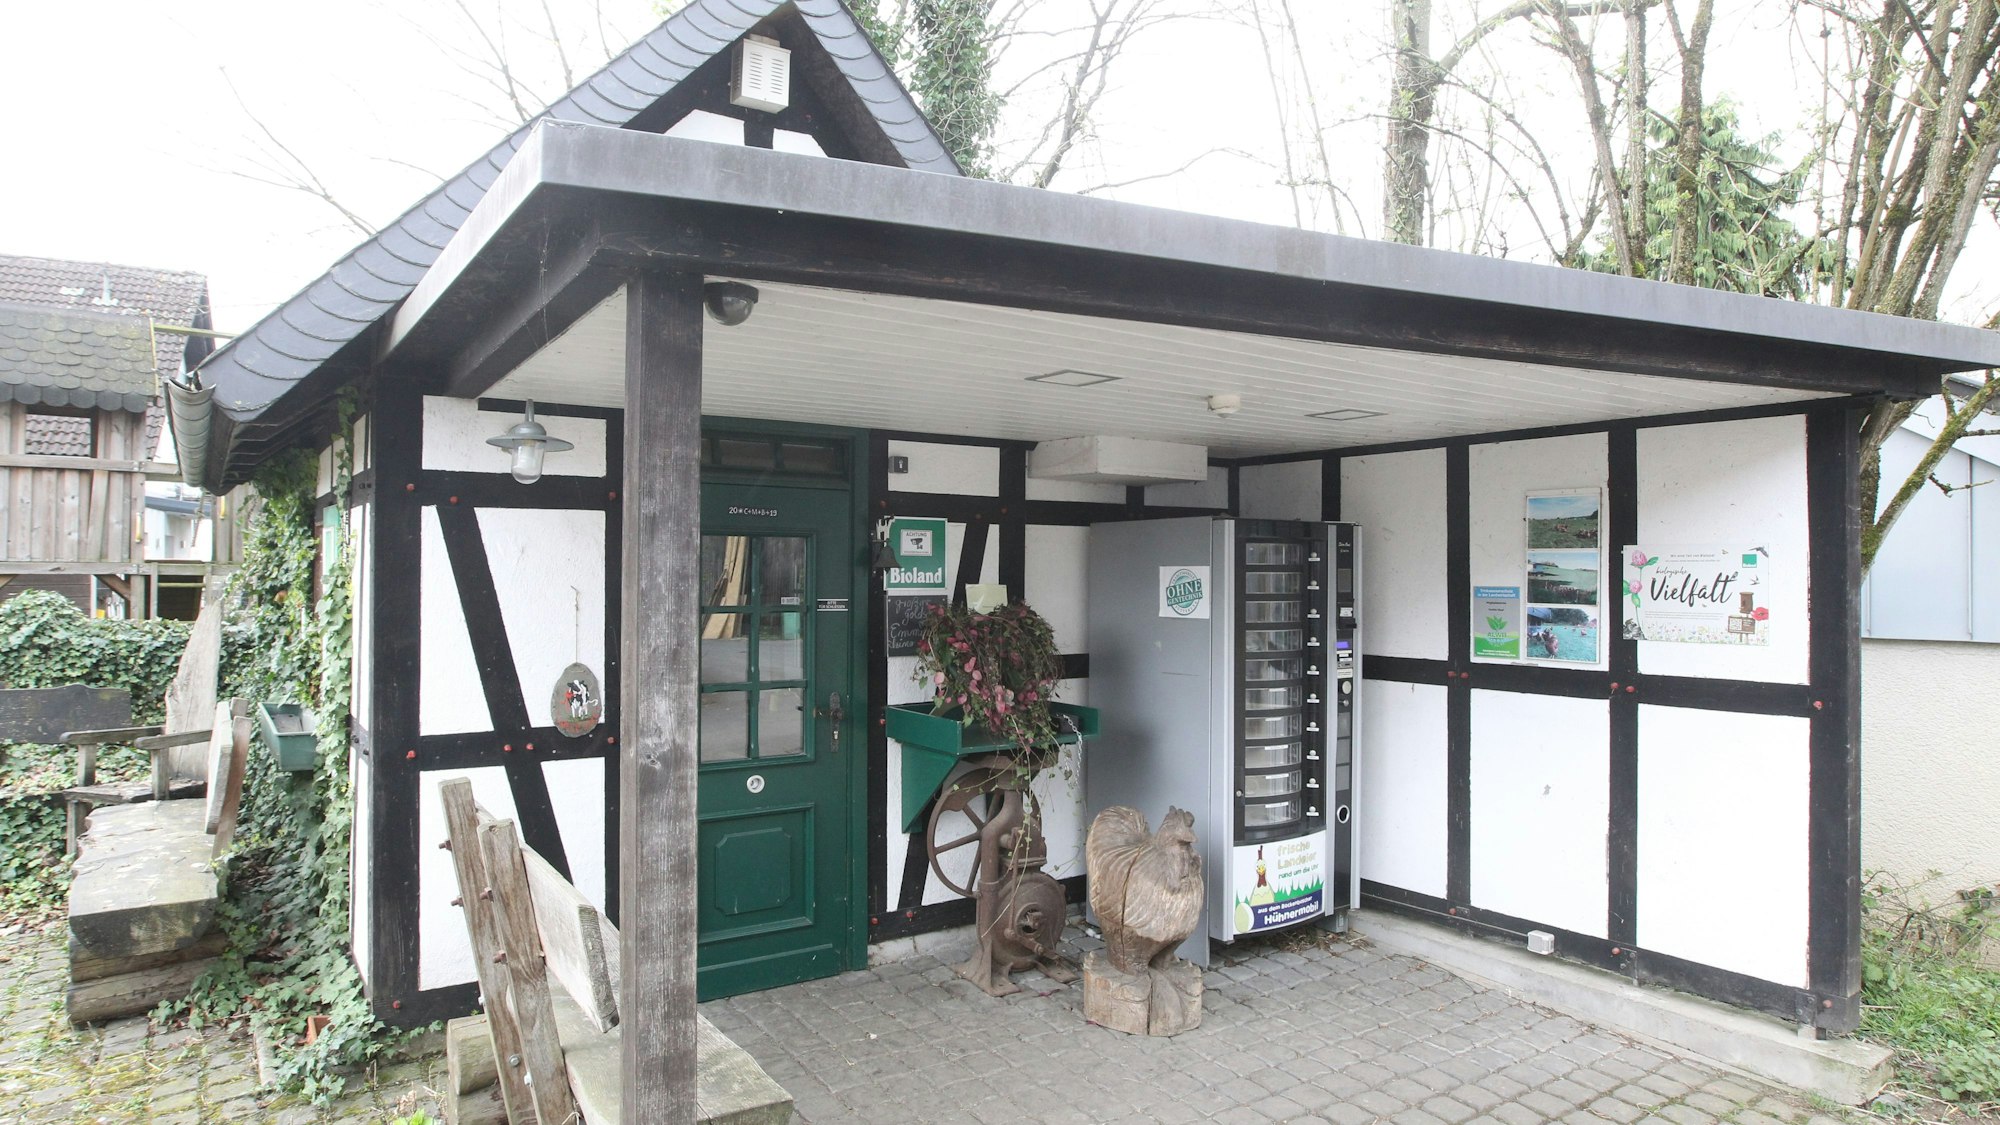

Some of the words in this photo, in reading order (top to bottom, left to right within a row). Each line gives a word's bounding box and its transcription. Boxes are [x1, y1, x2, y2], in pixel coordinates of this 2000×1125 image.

[889, 567, 943, 584] Bioland
[1166, 579, 1202, 599] OHNE
[1650, 571, 1737, 607] Vielfalt
[1167, 592, 1203, 605] GENTECHNIK
[1277, 841, 1311, 857] frische
[1278, 852, 1317, 870] Landeier
[1264, 900, 1319, 926] Hühnermobil
